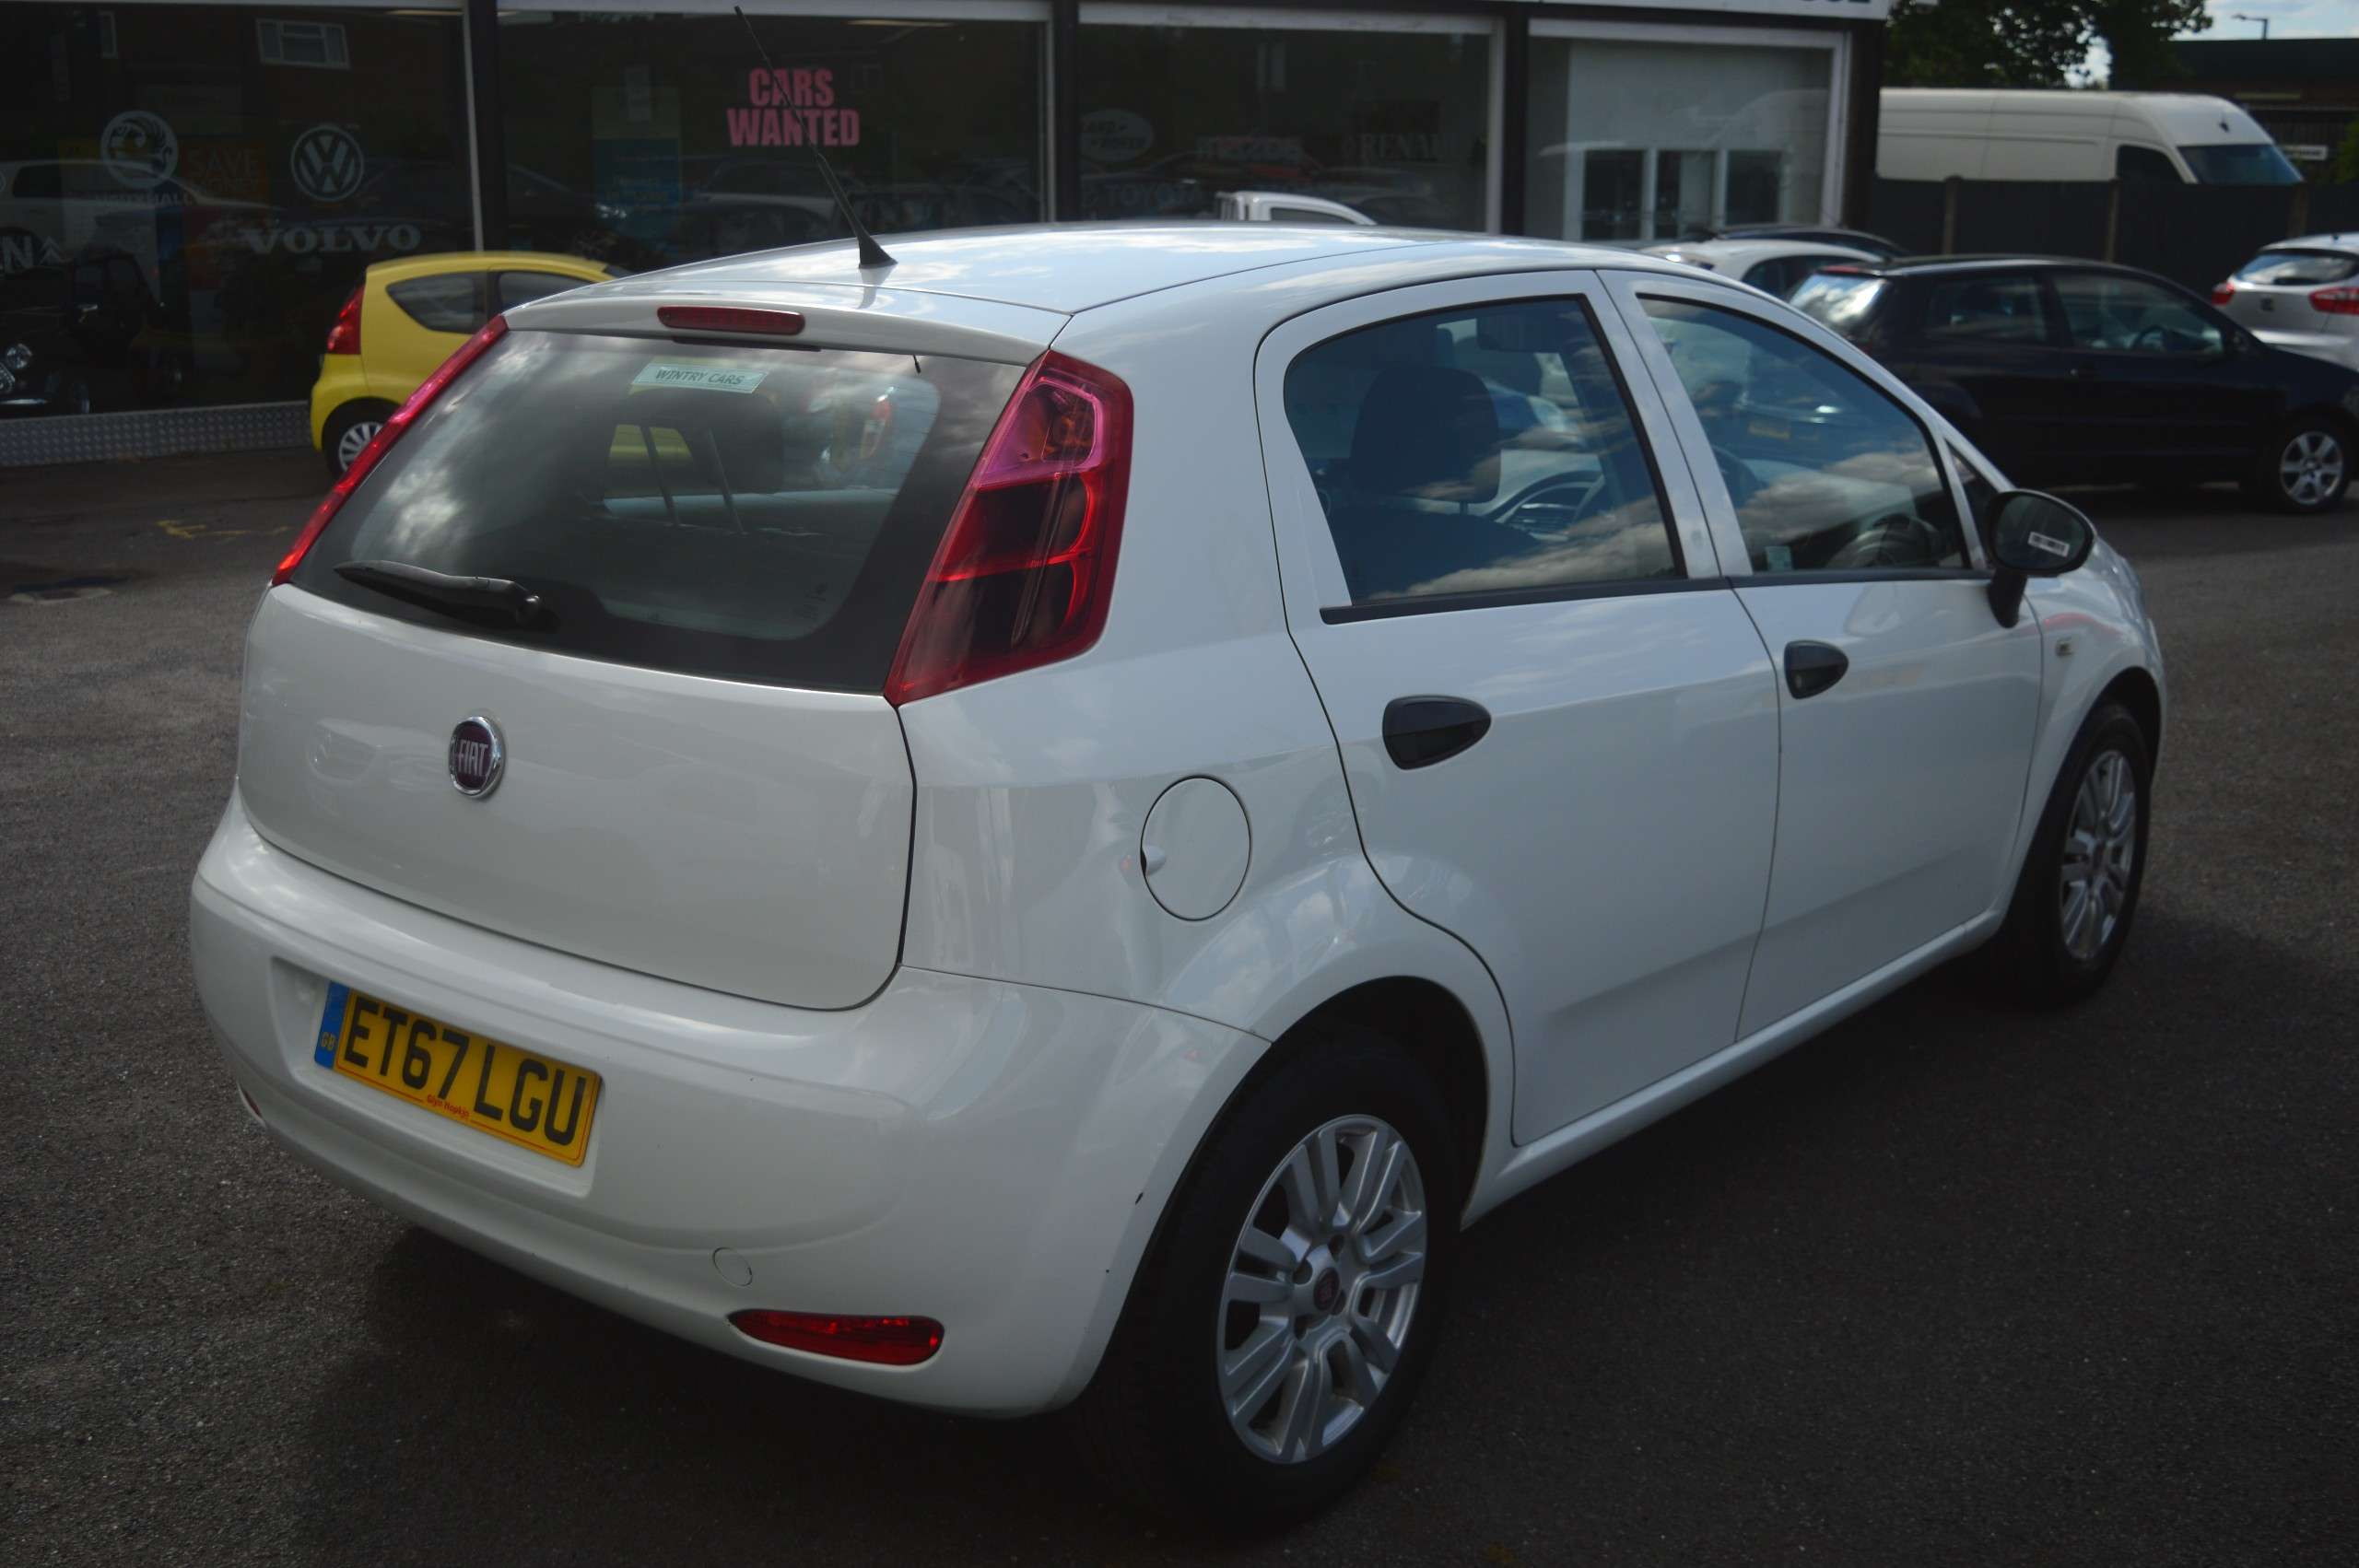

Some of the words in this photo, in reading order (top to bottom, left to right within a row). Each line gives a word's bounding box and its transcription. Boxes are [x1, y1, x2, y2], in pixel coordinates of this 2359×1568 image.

[748, 67, 835, 107] CARS
[726, 107, 861, 147] WANTED
[237, 223, 421, 255] VOLVO
[655, 369, 709, 382] WINTRY
[709, 371, 745, 385] CARS
[457, 738, 488, 777] FIAT
[343, 994, 470, 1100] ET67
[473, 1044, 587, 1146] LGU
